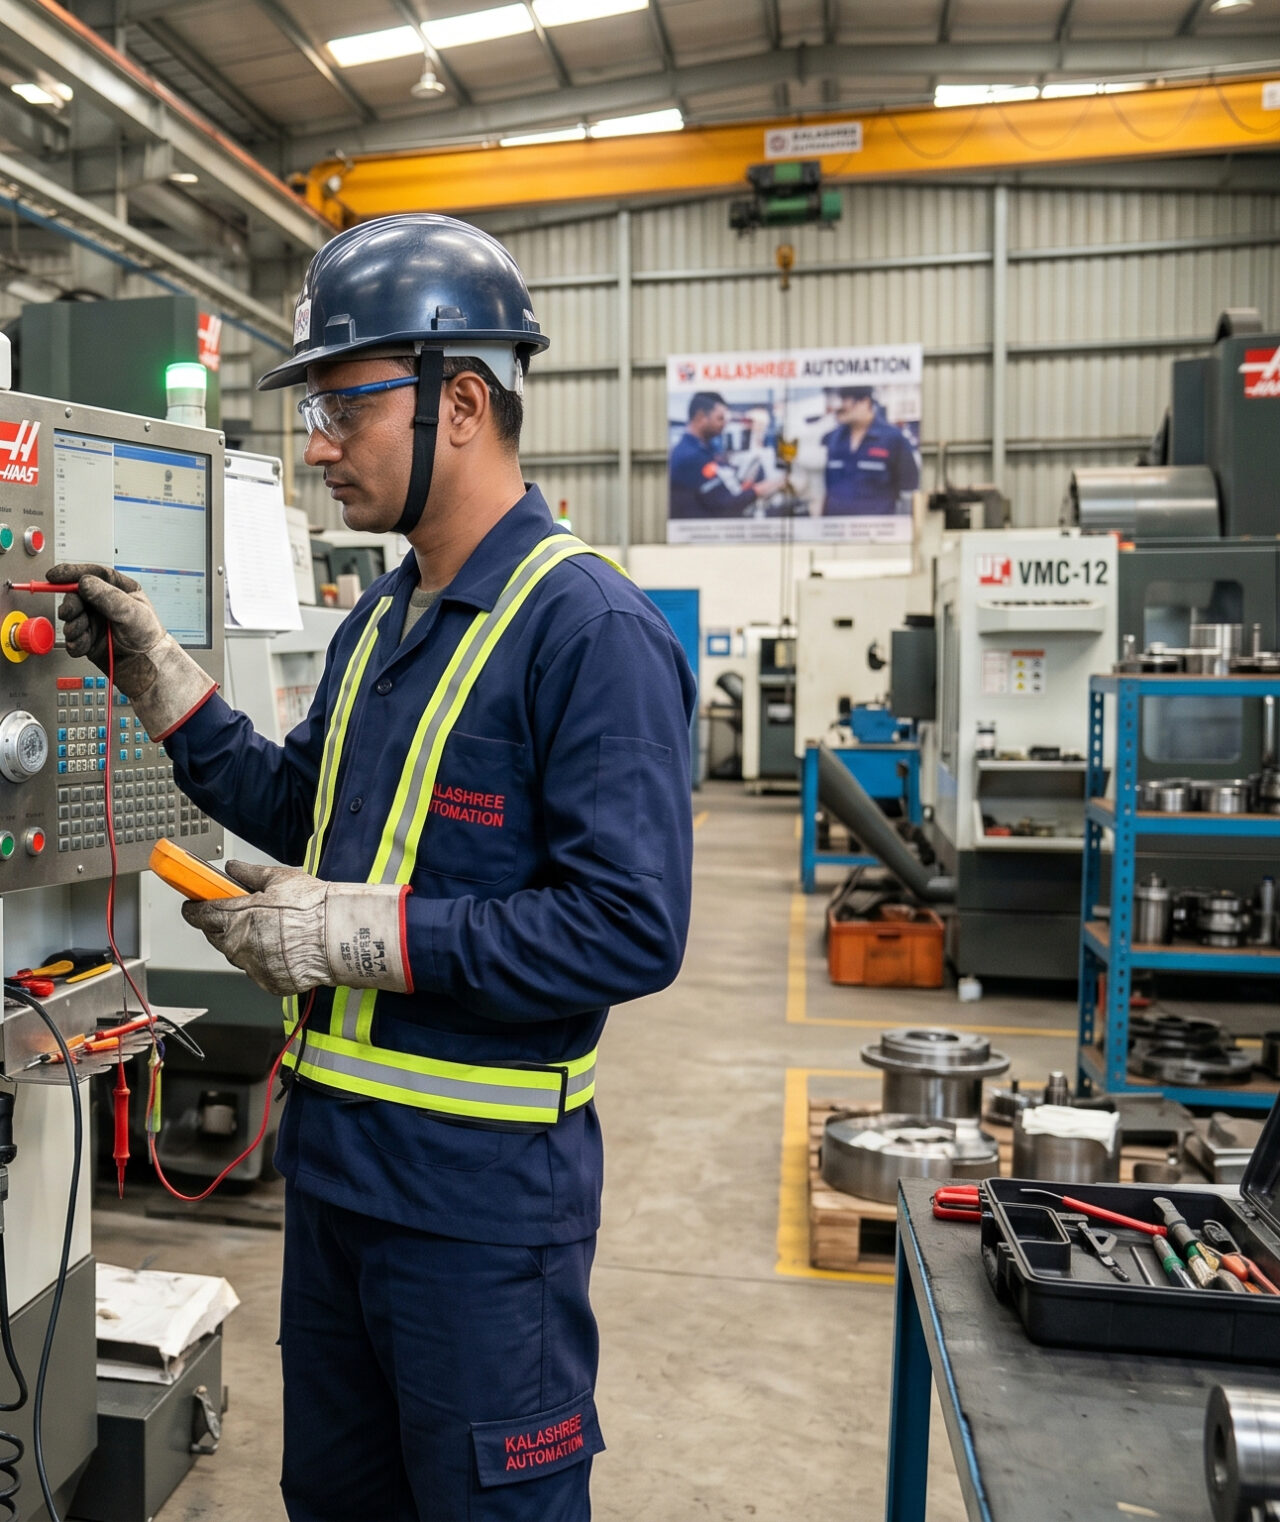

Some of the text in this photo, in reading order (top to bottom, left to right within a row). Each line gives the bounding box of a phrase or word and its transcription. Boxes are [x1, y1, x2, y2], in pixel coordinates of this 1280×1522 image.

[702, 356, 911, 380] KALASHREE AUTOMATION
[1018, 559, 1108, 585] VMC-12
[433, 783, 505, 810] LASHREE
[504, 1413, 582, 1453] KALASHREE
[505, 1433, 584, 1471] AUTOMATION
